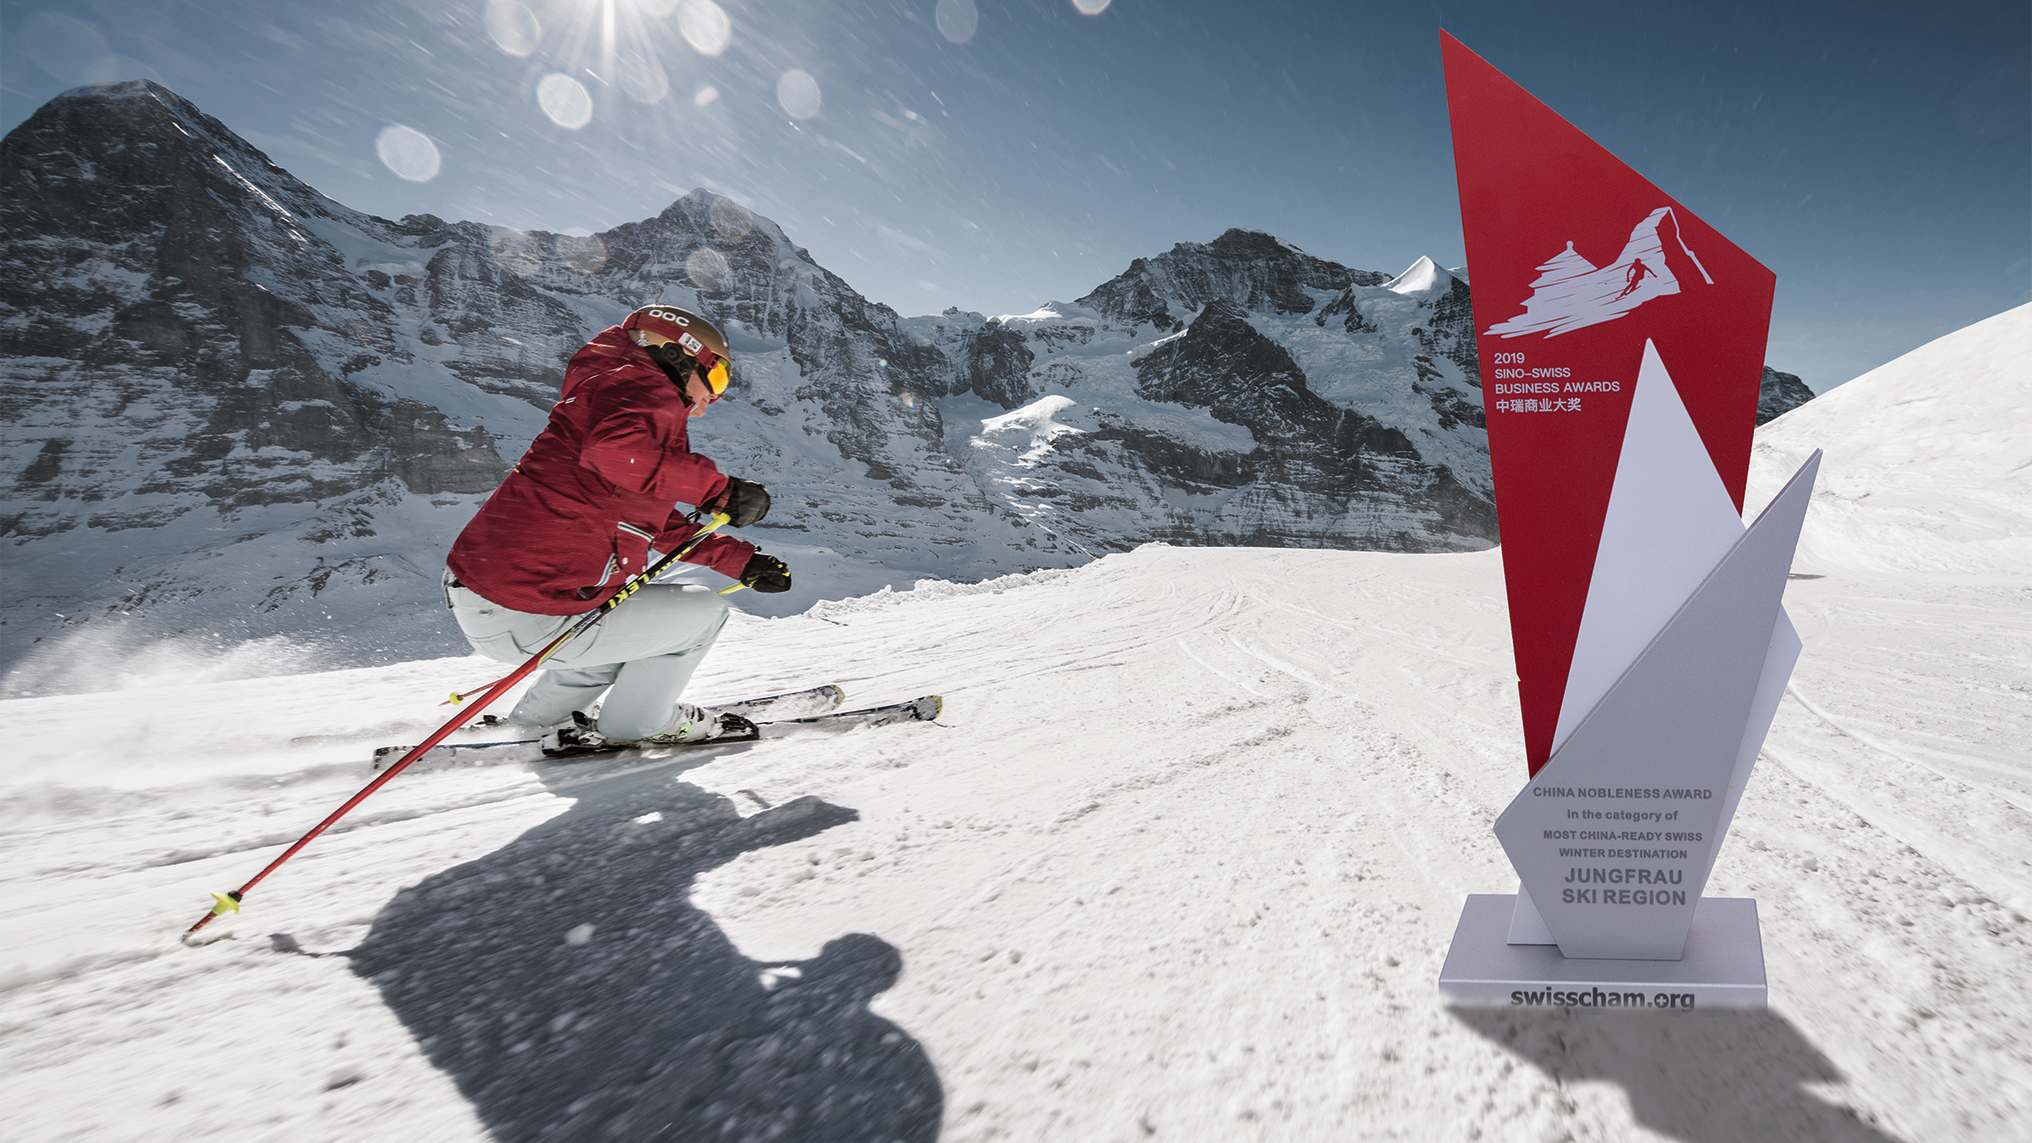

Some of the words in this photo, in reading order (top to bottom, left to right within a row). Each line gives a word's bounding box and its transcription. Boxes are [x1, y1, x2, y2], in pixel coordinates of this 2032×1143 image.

[1494, 352, 1525, 364] 2019
[1495, 383, 1559, 395] BUSINESS
[1563, 381, 1620, 392] AWARDS
[1496, 397, 1582, 413] 中瑞商业大奖
[1533, 787, 1575, 798] CHINA
[1577, 788, 1660, 799] NOBLENESS
[1663, 789, 1712, 800] AWARD
[1567, 809, 1579, 820] In
[1582, 809, 1602, 820] the
[1605, 810, 1661, 823] category
[1665, 810, 1679, 821] of
[1543, 830, 1577, 840] MOST
[1579, 831, 1662, 841] CHINA-READY
[1665, 832, 1703, 842] SWISS
[1559, 848, 1606, 858] WINTER
[1608, 848, 1688, 859] DESTINATION
[1564, 867, 1683, 885] JUNGFRAU
[1562, 889, 1597, 905] SKI
[1603, 889, 1687, 906] REGION
[1510, 986, 1696, 1013] swisscham.org
